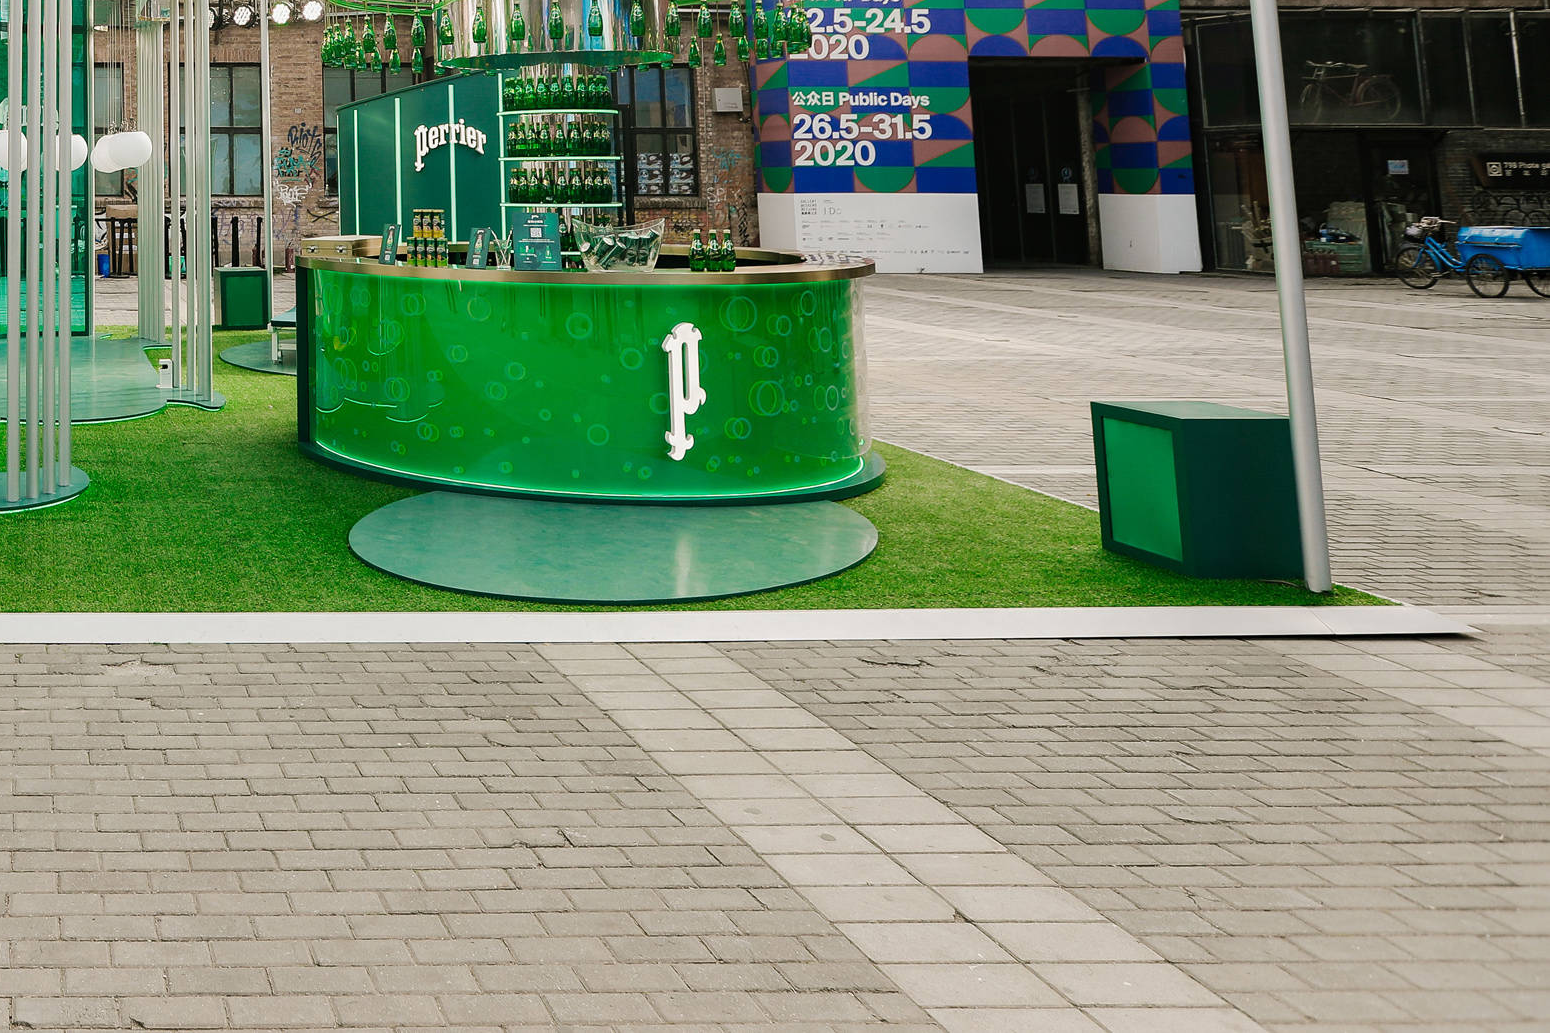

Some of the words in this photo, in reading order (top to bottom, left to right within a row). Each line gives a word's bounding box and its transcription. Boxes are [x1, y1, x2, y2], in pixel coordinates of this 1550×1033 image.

[787, 7, 932, 34] 2.5-24.5
[789, 34, 870, 60] 020
[792, 91, 834, 106] 公众日
[839, 92, 887, 106] Public
[890, 92, 930, 108] Days
[793, 113, 933, 140] 26.5-31.5
[413, 118, 487, 172] perrier
[794, 140, 876, 167] 2020
